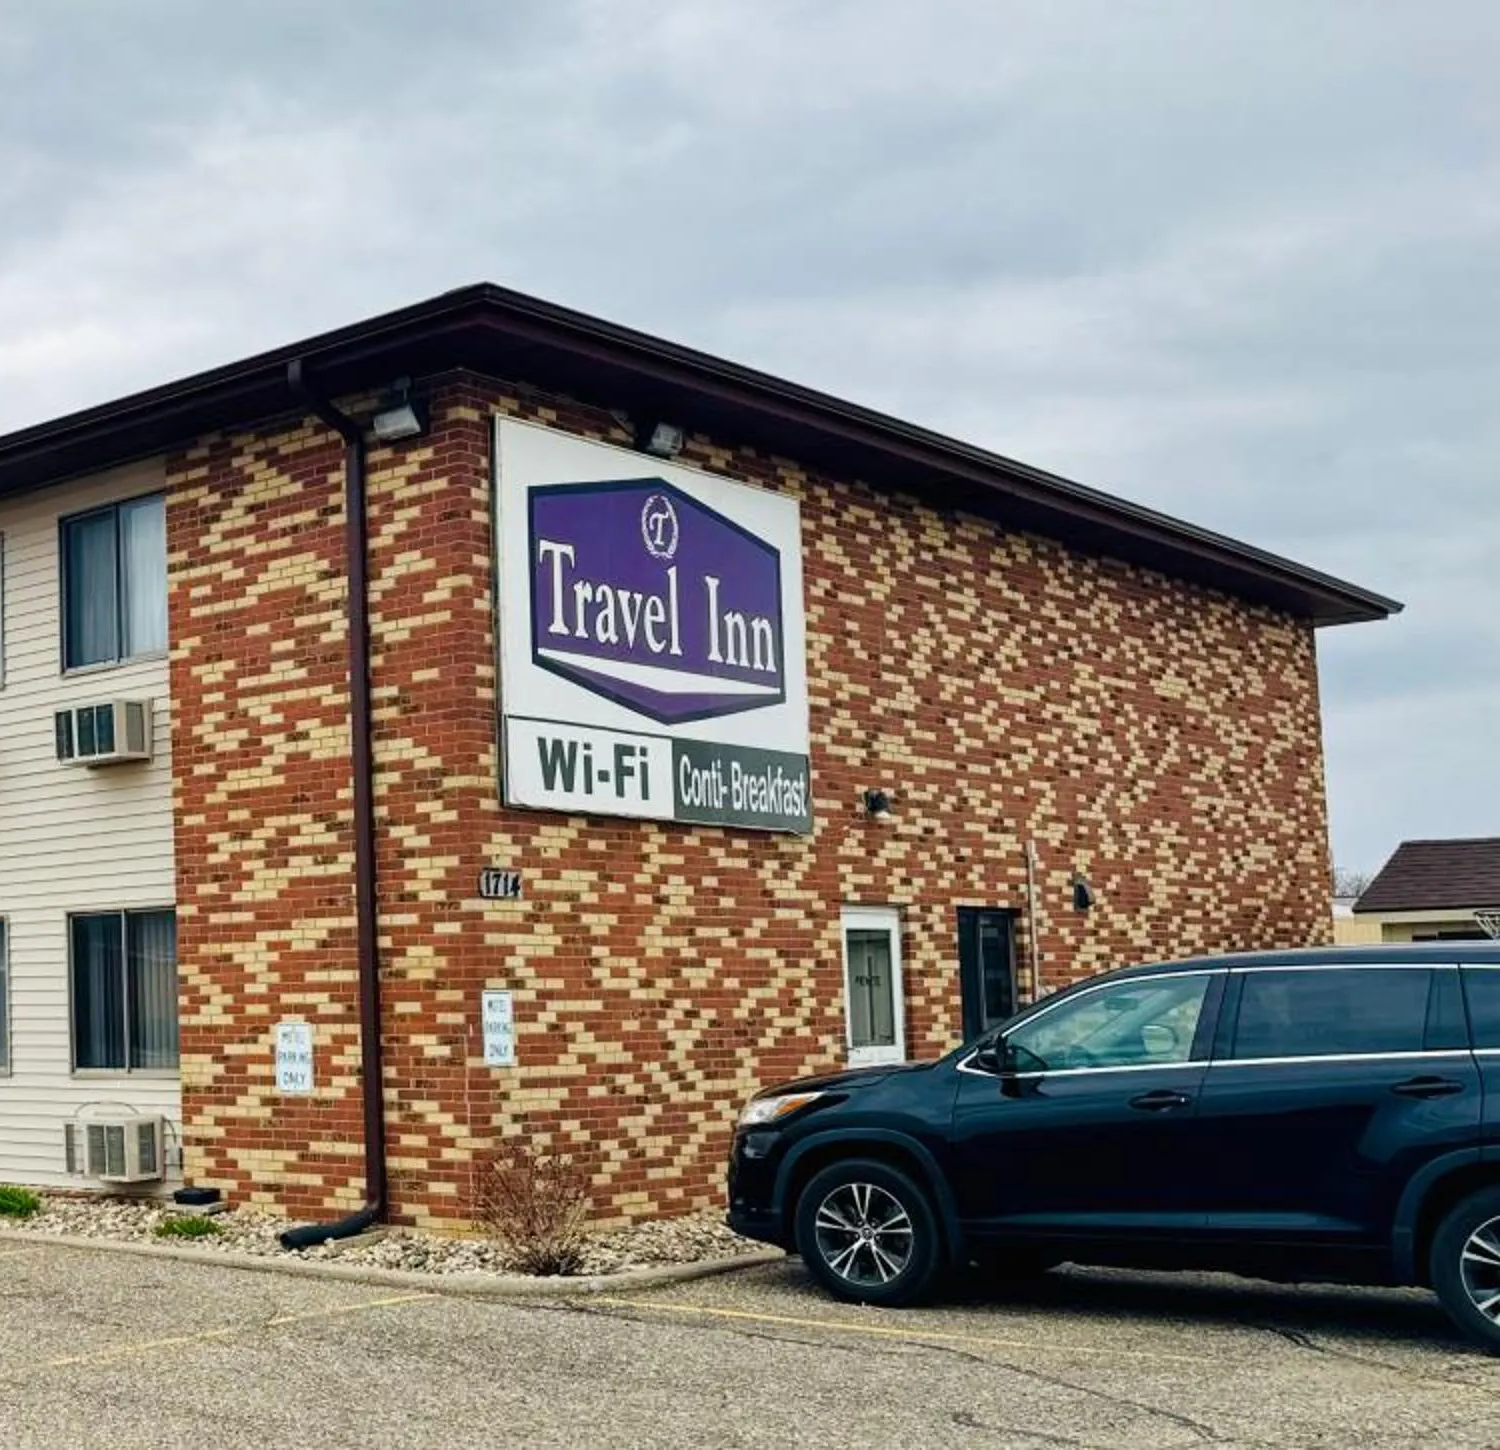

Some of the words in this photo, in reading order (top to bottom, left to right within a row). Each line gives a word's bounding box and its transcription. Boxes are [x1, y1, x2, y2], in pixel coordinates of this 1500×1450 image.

[649, 511, 669, 545] T
[538, 539, 683, 656] Travel
[704, 575, 777, 673] Inn
[537, 737, 650, 801] Wi-Fi
[679, 754, 727, 810] Conti-
[730, 762, 807, 817] Breakfast
[485, 871, 520, 897] 1714
